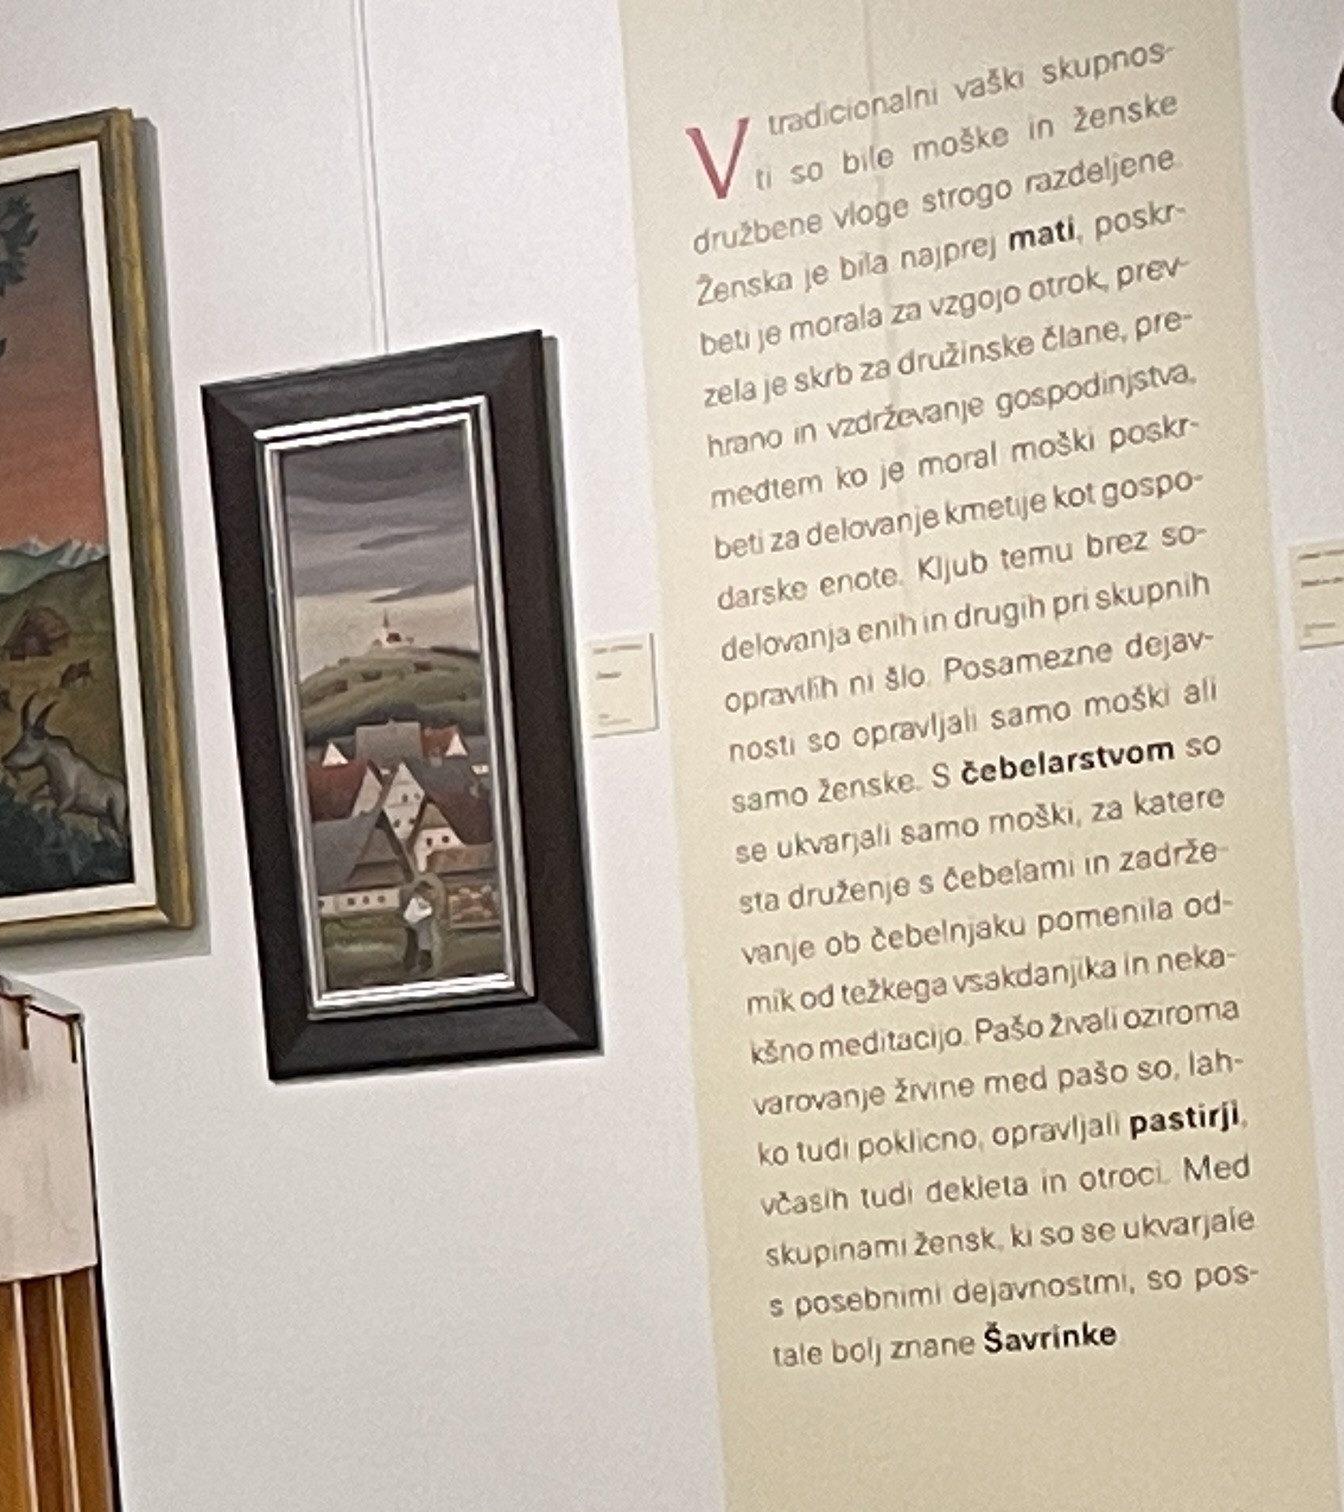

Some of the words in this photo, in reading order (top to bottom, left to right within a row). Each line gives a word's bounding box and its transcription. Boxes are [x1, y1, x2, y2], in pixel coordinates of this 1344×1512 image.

[685, 116, 750, 199] V
[768, 85, 938, 136] tradicionalni
[953, 66, 1025, 102] vaški
[1041, 42, 1174, 85] skupnos-
[755, 168, 772, 191] ti
[790, 161, 824, 185] so
[842, 144, 894, 175] bile
[912, 125, 1009, 162] moške
[1028, 118, 1055, 141] in
[1073, 93, 1178, 133] ženske
[693, 213, 823, 256] družbene
[832, 197, 909, 230] vloge
[922, 178, 1013, 214] strogo
[696, 269, 793, 307] Ženska
[804, 264, 829, 294] je
[839, 251, 889, 282] bila
[900, 235, 997, 272] najprej
[1008, 214, 1084, 252] mati,
[1094, 200, 1186, 243] poskr-
[699, 328, 751, 357] beti
[757, 324, 782, 355] je
[789, 303, 883, 342] morala
[890, 301, 922, 326] za
[928, 284, 1022, 320] vzgojo
[1116, 256, 1189, 292] prev-
[704, 377, 758, 408] zela
[763, 375, 788, 405] je
[794, 361, 854, 393] skrb
[858, 358, 892, 383] za
[896, 333, 1035, 376] družinske
[1134, 311, 1193, 343] pre-
[706, 428, 783, 458] hrano
[793, 422, 818, 445] in
[826, 396, 985, 440] vzdrževanje
[710, 473, 824, 509] medtem
[835, 465, 869, 491] ko
[879, 460, 905, 491] je
[918, 439, 997, 478] moral
[1011, 427, 1096, 463] moški
[1108, 414, 1200, 454] poskr-
[714, 532, 765, 561] beti
[770, 529, 800, 553] za
[805, 505, 941, 547] delovanje
[944, 492, 1048, 526] kmetije
[1052, 482, 1097, 510] kot
[1101, 470, 1204, 509] gospo-
[717, 577, 808, 611] darske
[917, 549, 989, 586] Kljub
[999, 542, 1074, 571] temu
[1086, 530, 1149, 559] brez
[1161, 524, 1207, 548] so-
[721, 626, 852, 662] delovanja
[856, 612, 917, 644] enih
[922, 612, 948, 634] in
[953, 593, 1046, 630] drugih
[1052, 592, 1090, 623] pri
[1095, 571, 1211, 611] skupnih
[724, 674, 839, 716] opravilih
[849, 673, 874, 696] ni
[943, 641, 1114, 684] Posamezne
[1125, 630, 1214, 662] dejav-
[728, 734, 796, 763] nosti
[807, 730, 841, 754] so
[852, 706, 978, 751] opravljali
[990, 700, 1072, 731] samo
[1084, 683, 1170, 718] moški
[1183, 676, 1217, 706] ali
[731, 786, 809, 814] samo
[931, 761, 951, 790] S
[960, 740, 1176, 786] čebelarstvom
[1185, 734, 1222, 758] so
[735, 842, 768, 865] se
[776, 822, 891, 860] ukvarjali
[900, 816, 980, 846] samo
[988, 801, 1082, 835] moški,
[1091, 799, 1124, 823] za
[1133, 787, 1226, 816] katere
[738, 891, 781, 915] sta
[787, 876, 911, 910] druženje
[918, 873, 935, 895] s
[942, 858, 1075, 893] čebelami
[1084, 854, 1110, 876] in
[1118, 837, 1229, 873] zadrže-
[740, 939, 816, 967] vanje
[824, 930, 861, 957] ob
[870, 913, 1026, 953] čebelnjaku
[1037, 896, 1174, 940] pomenila
[1183, 889, 1233, 919] od-
[746, 987, 796, 1016] mik
[799, 982, 835, 1011] od
[840, 976, 948, 1006] težkega
[952, 955, 1117, 994] vsakdanjika
[1123, 952, 1150, 977] in
[1156, 943, 1236, 975] neka-
[750, 1038, 815, 1065] kšno
[974, 1013, 1045, 1044] Pašo
[1048, 1006, 1118, 1039] živali
[1123, 999, 1240, 1030] oziroma
[752, 1085, 886, 1117] varovanje
[894, 1077, 975, 1104] živine
[983, 1064, 1048, 1095] med
[1057, 1059, 1129, 1094] pašo
[1188, 1047, 1244, 1077] lah-
[757, 1141, 789, 1167] ko
[795, 1136, 849, 1164] tudi
[991, 1111, 1121, 1150] opravljali
[760, 1187, 849, 1217] včasih
[859, 1180, 913, 1210] tudi
[925, 1174, 1029, 1204] dekleta
[1041, 1173, 1067, 1195] in
[1183, 1152, 1251, 1183] Med
[765, 1237, 907, 1269] skupinami
[1009, 1222, 1033, 1248] ki
[1039, 1225, 1075, 1247] so
[1080, 1221, 1116, 1244] se
[1123, 1205, 1255, 1241] ukvarjale
[769, 1298, 785, 1318] s
[795, 1283, 942, 1321] posebnimi
[952, 1272, 1136, 1308] dejavnostmi,
[1146, 1268, 1183, 1291] so
[1194, 1263, 1259, 1293] pos-
[772, 1342, 823, 1368] tale
[831, 1336, 882, 1368] bolj
[890, 1335, 976, 1361] znane
